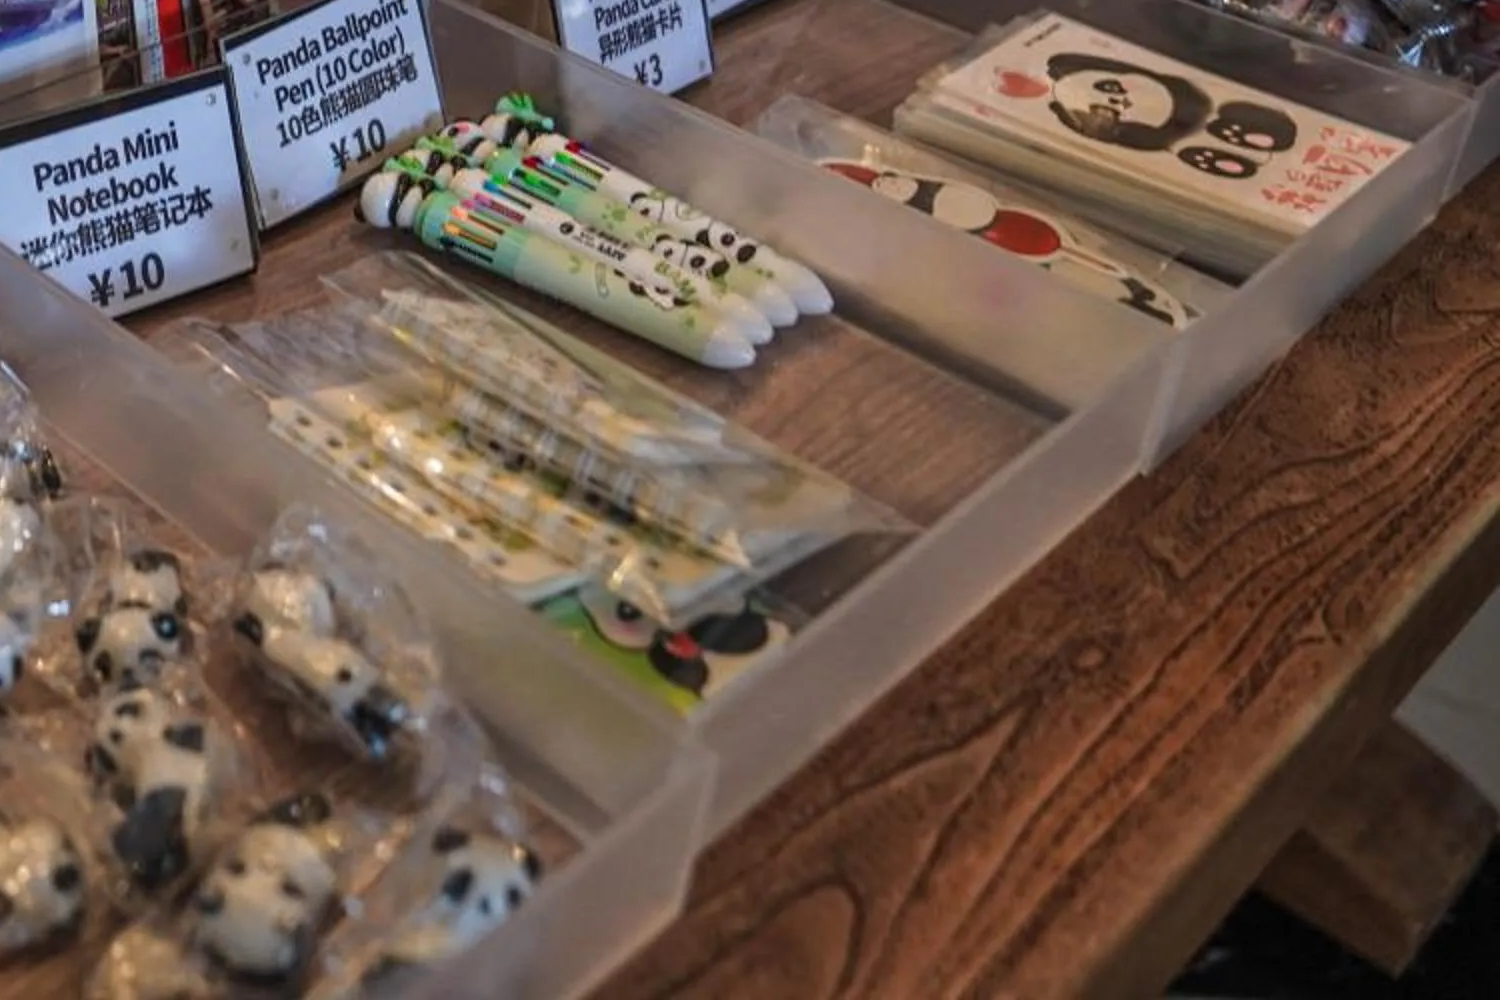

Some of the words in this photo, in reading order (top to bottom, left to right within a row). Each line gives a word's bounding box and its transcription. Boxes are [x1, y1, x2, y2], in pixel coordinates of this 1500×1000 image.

[256, 35, 323, 85] Panda
[274, 76, 315, 113] Pen
[315, 55, 348, 95] (10
[349, 25, 406, 74] Color)
[633, 53, 664, 86] ¥3
[33, 143, 120, 192] Panda
[122, 120, 180, 164] Mini
[329, 118, 387, 172] ¥10
[47, 161, 179, 226] Notebook
[20, 184, 214, 271] 迷你熊猫笔记本
[87, 251, 166, 307] ¥10
